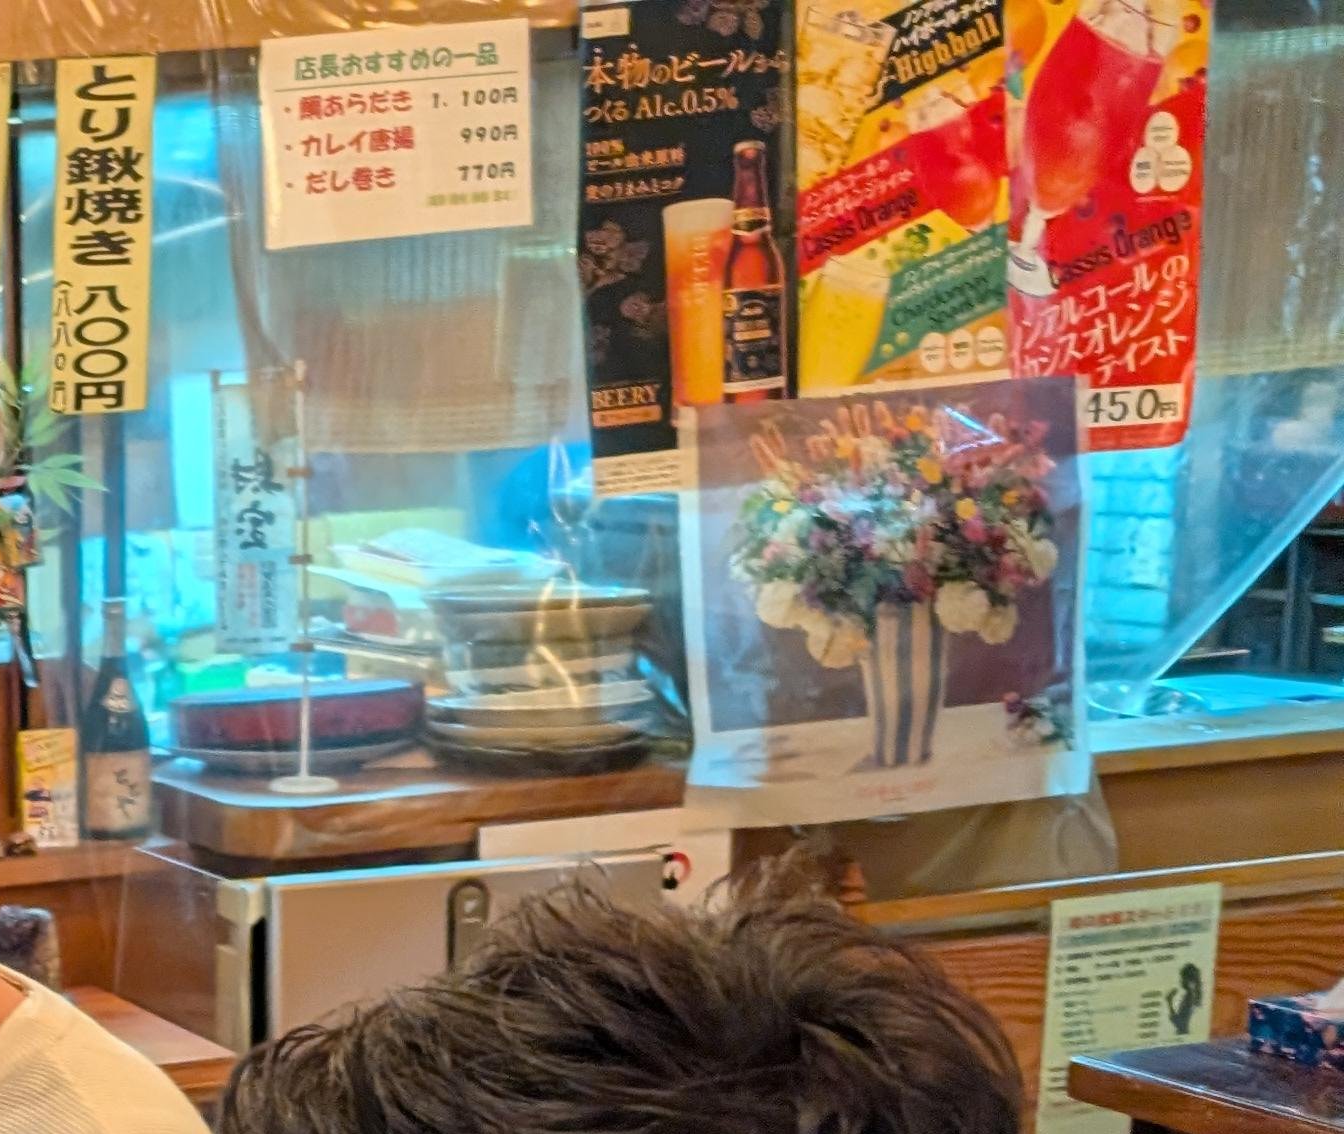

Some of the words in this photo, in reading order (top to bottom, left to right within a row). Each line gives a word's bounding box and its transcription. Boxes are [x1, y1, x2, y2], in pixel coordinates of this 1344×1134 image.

[294, 42, 500, 81] 店長おすすめの一品
[889, 12, 1002, 84] Highball
[459, 123, 518, 144] 990円
[304, 166, 396, 195] だし巻き
[456, 161, 517, 182] 770円
[1112, 209, 1194, 259] Orange
[1014, 254, 1191, 350] ンアルコールの
[1085, 386, 1179, 424] 450円
